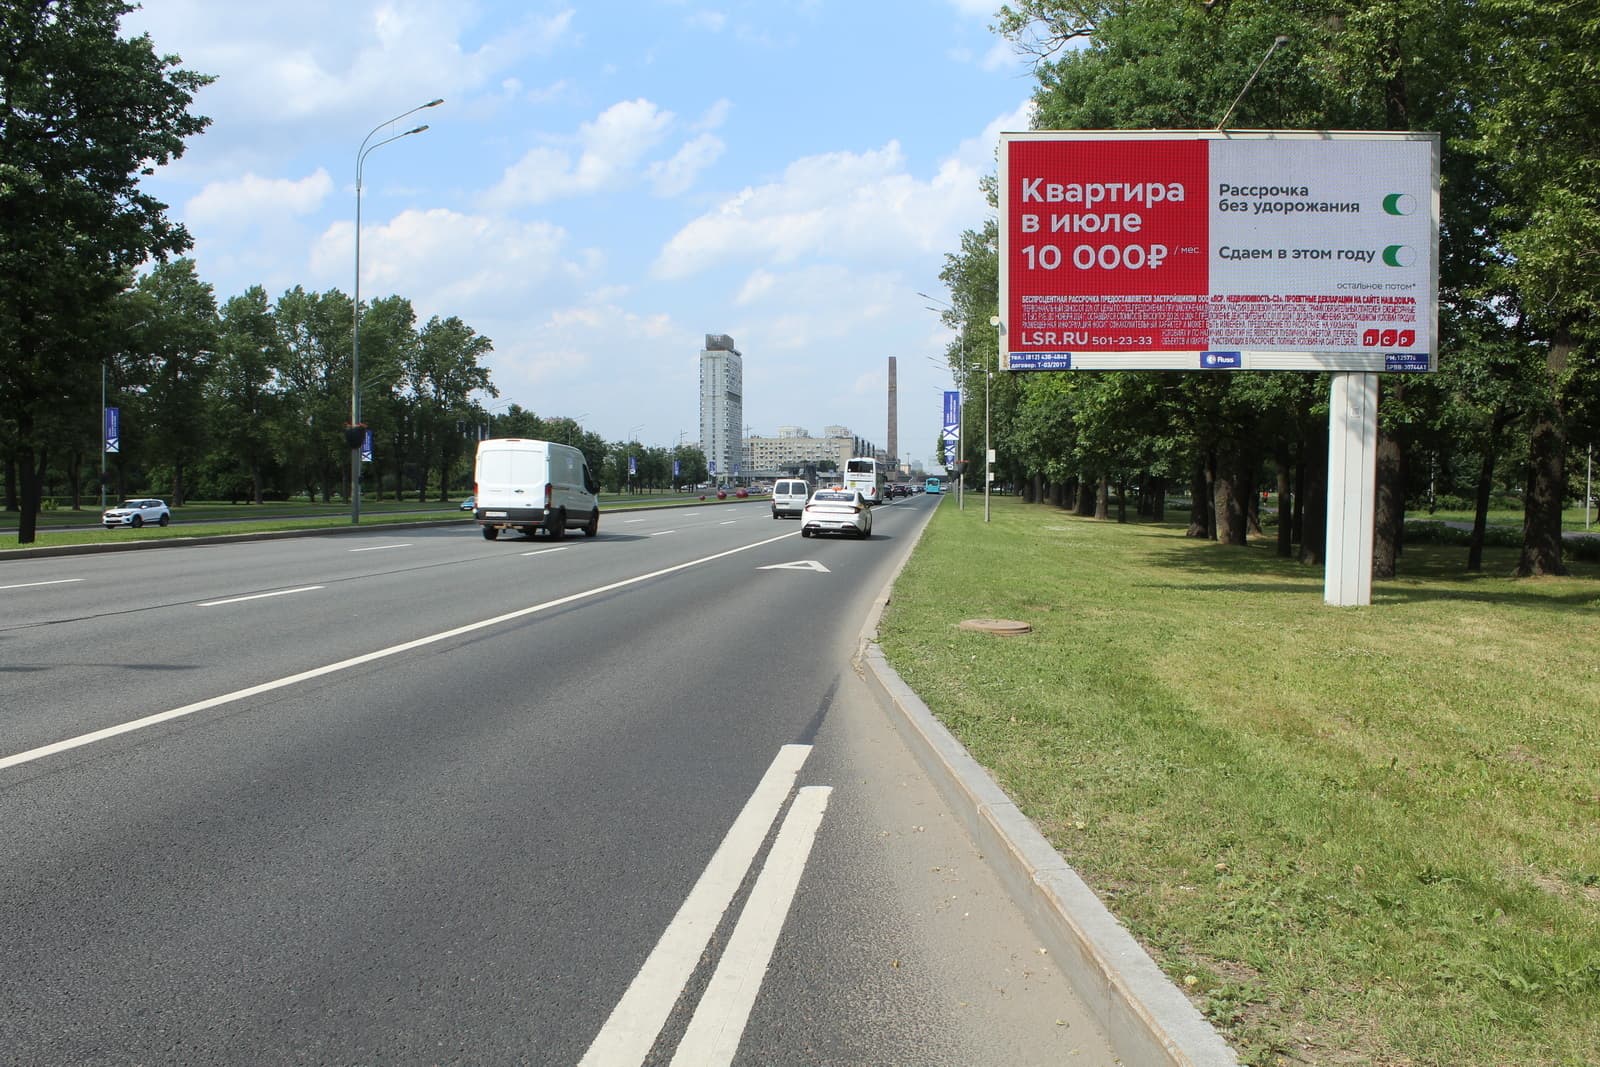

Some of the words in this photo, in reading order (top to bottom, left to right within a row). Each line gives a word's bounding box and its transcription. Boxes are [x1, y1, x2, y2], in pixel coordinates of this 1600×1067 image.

[1022, 177, 1185, 209] Квартира
[1219, 183, 1309, 199] Рассрочка
[1218, 198, 1249, 212] без
[1253, 201, 1360, 215] удорожания
[1022, 213, 1040, 232] в
[1051, 213, 1142, 232] июле
[1021, 244, 1062, 270] 10
[1219, 246, 1273, 261] Сдаем
[1278, 249, 1287, 259] в
[1291, 249, 1332, 260] этом
[1337, 249, 1376, 264] году
[1336, 282, 1383, 291] остальное
[1021, 331, 1089, 346] LSR.RU
[1092, 336, 1153, 345] 501-23-33
